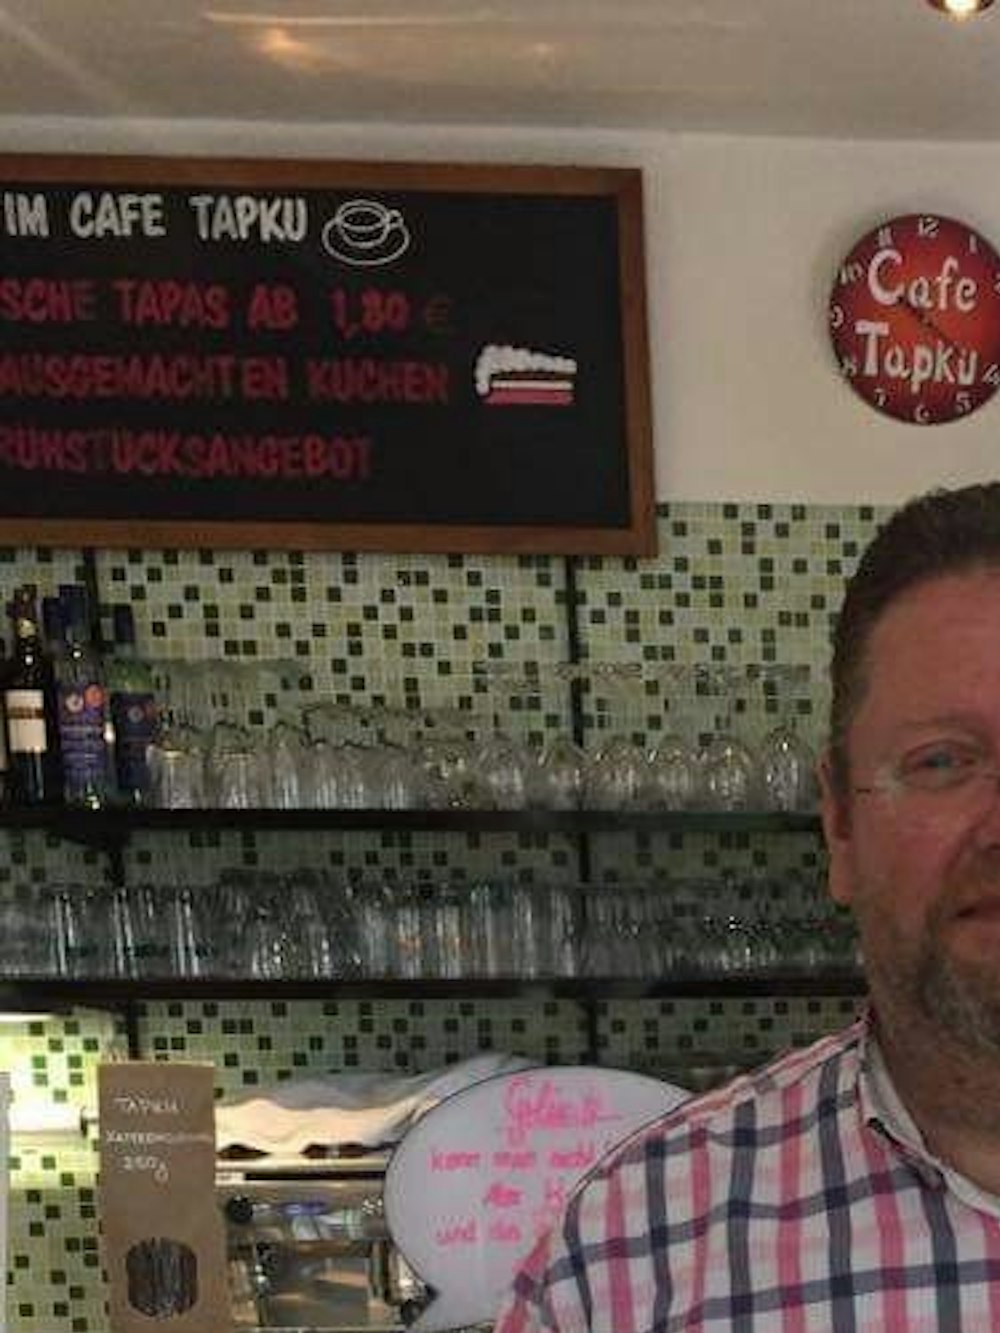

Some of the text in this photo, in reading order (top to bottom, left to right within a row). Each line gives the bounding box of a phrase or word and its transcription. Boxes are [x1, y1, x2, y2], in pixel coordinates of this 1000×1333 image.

[4, 192, 309, 243] IM CAFE TAPKU
[918, 217, 939, 238] 12
[118, 280, 227, 331] TAPAS
[247, 286, 297, 331] AB
[868, 249, 978, 312] Cafe
[855, 319, 978, 394] Tapku
